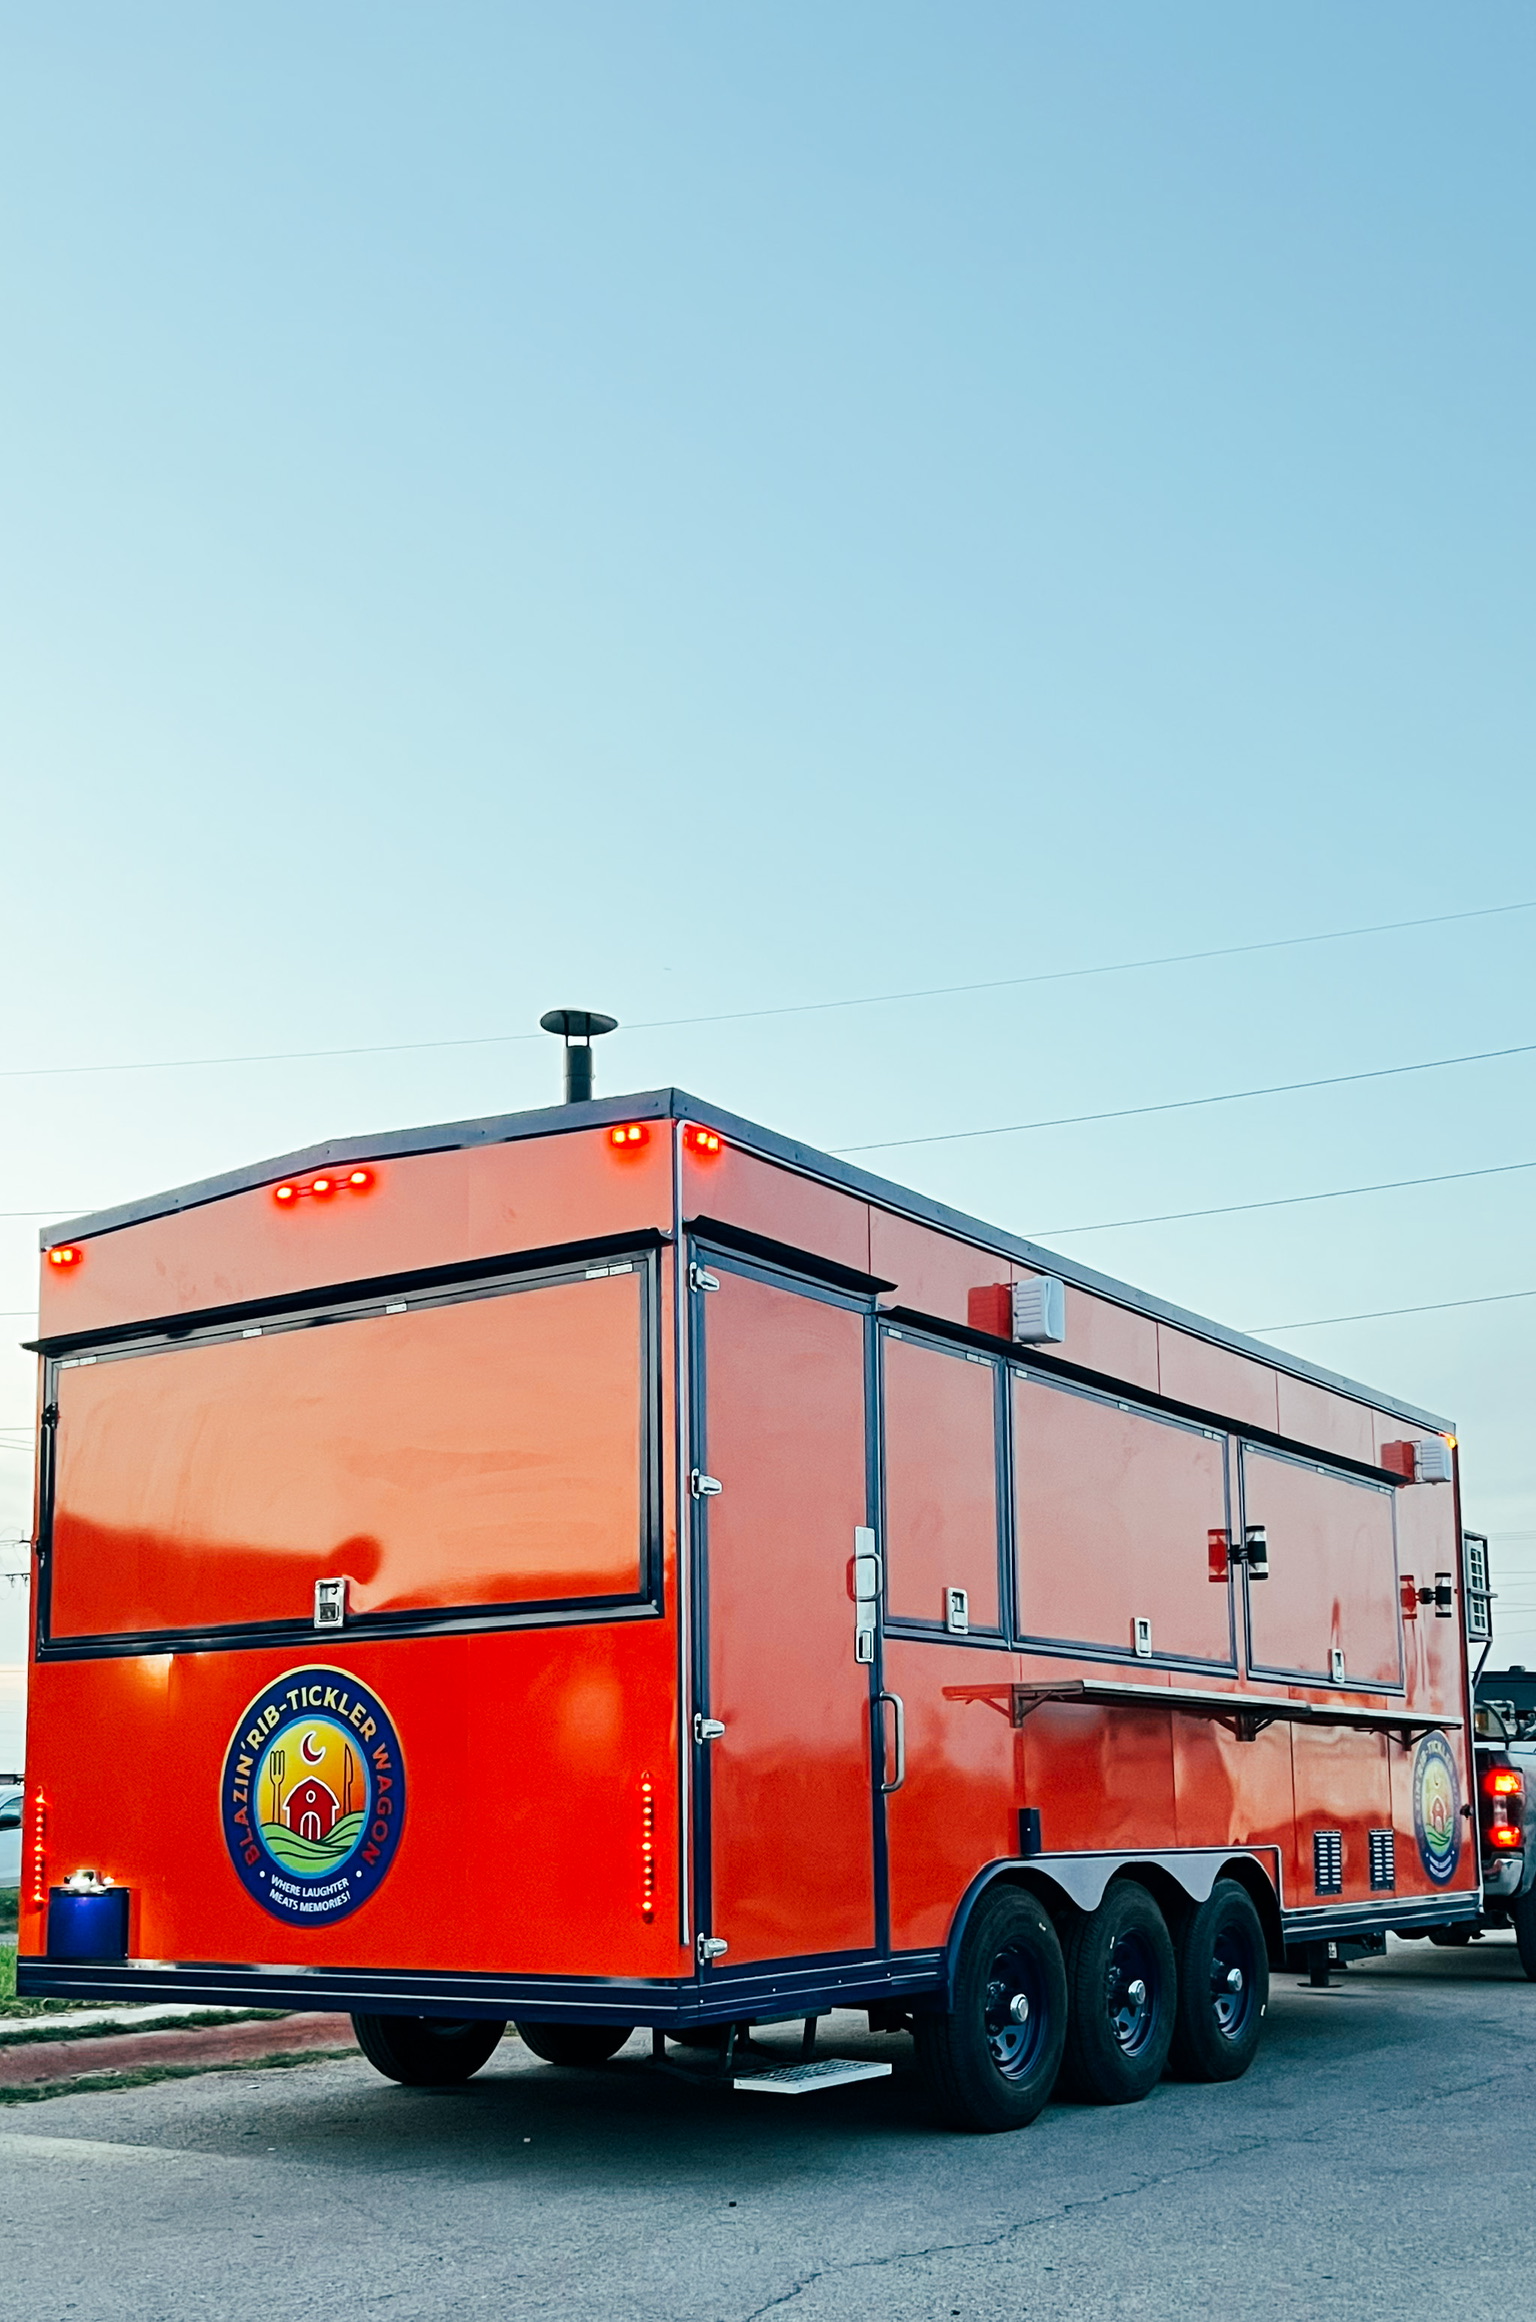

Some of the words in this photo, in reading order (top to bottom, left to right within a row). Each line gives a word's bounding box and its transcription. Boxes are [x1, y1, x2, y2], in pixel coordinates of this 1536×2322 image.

[246, 1685, 376, 1750] RIB-TICKLER
[362, 1743, 393, 1866] WAGON
[271, 1874, 301, 1896] WHERE
[302, 1877, 349, 1897] LAUGHTER
[269, 1888, 298, 1910] MEATS
[299, 1890, 351, 1912] MEMORIES!
